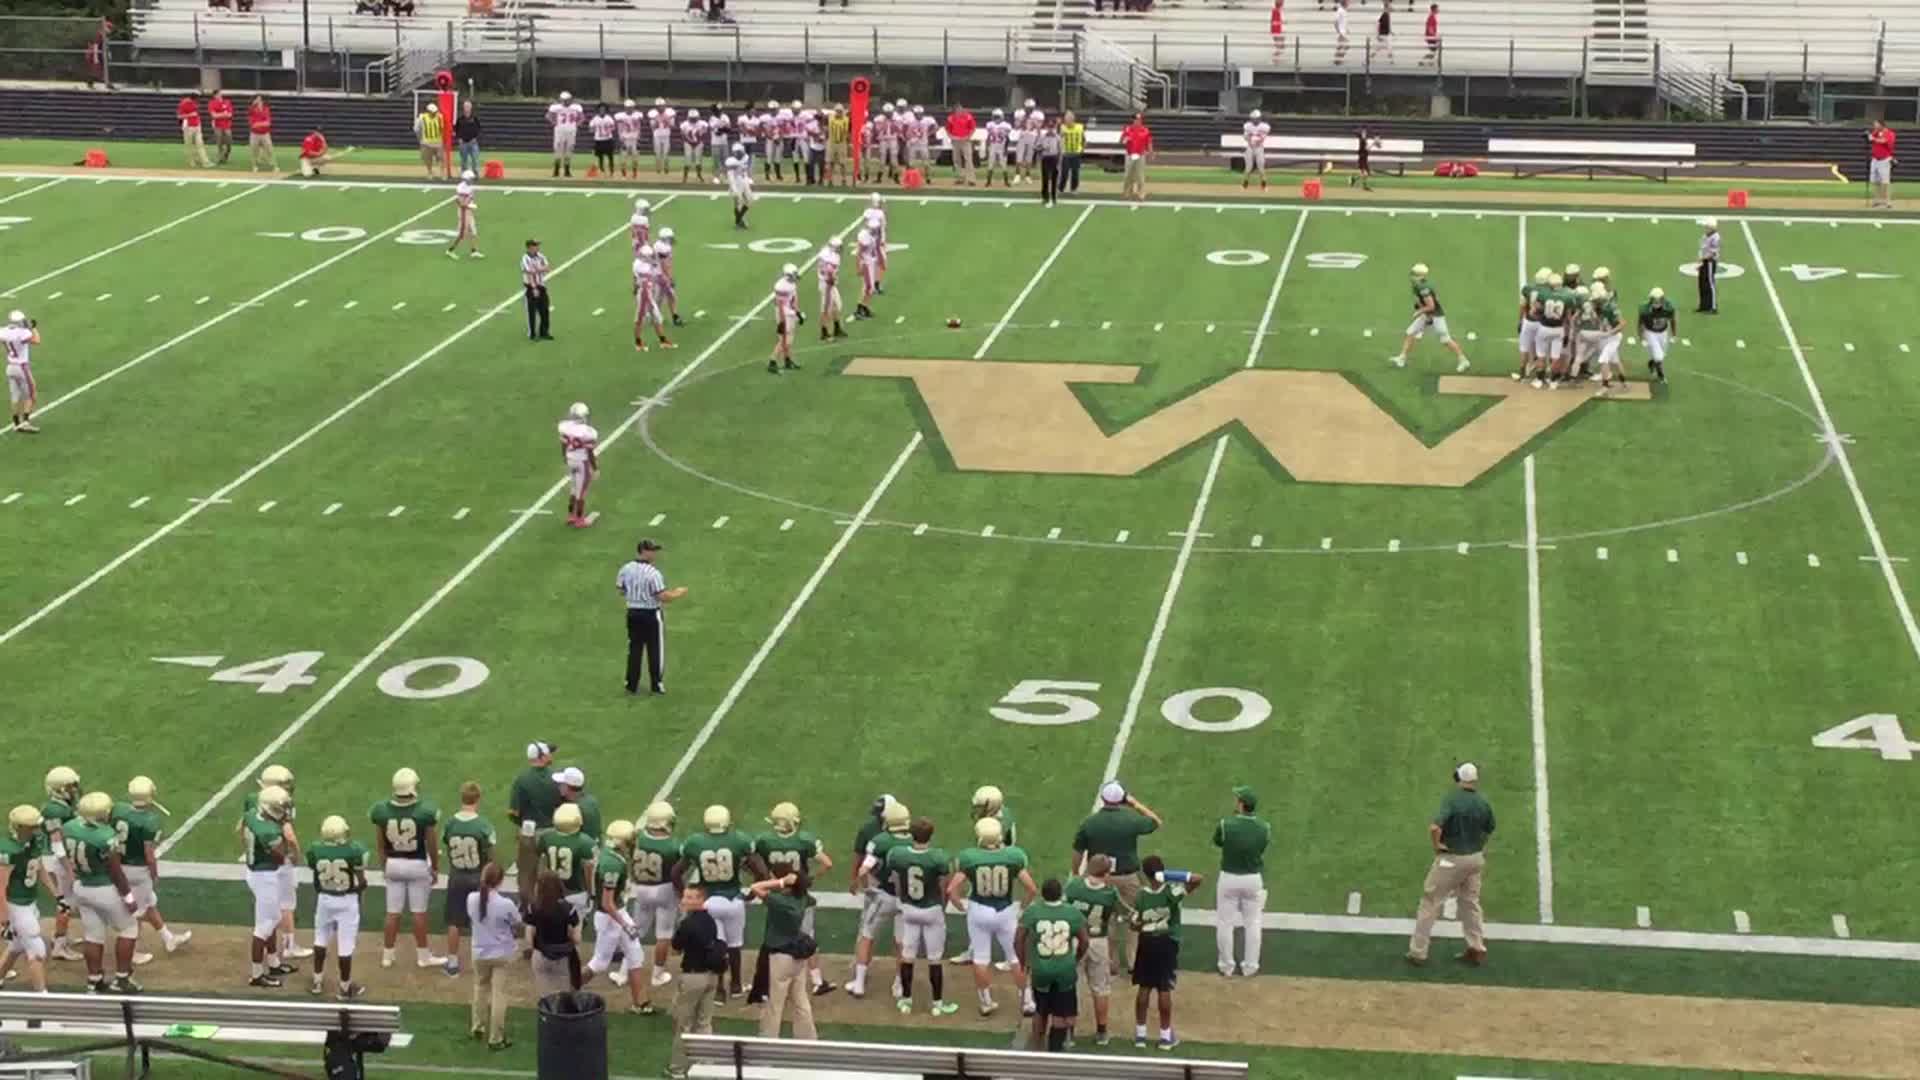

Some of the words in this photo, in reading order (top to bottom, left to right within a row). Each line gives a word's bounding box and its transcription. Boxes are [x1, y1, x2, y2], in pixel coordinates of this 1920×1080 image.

[841, 357, 1652, 487] W
[548, 846, 573, 881] 13
[907, 865, 926, 901] 6
